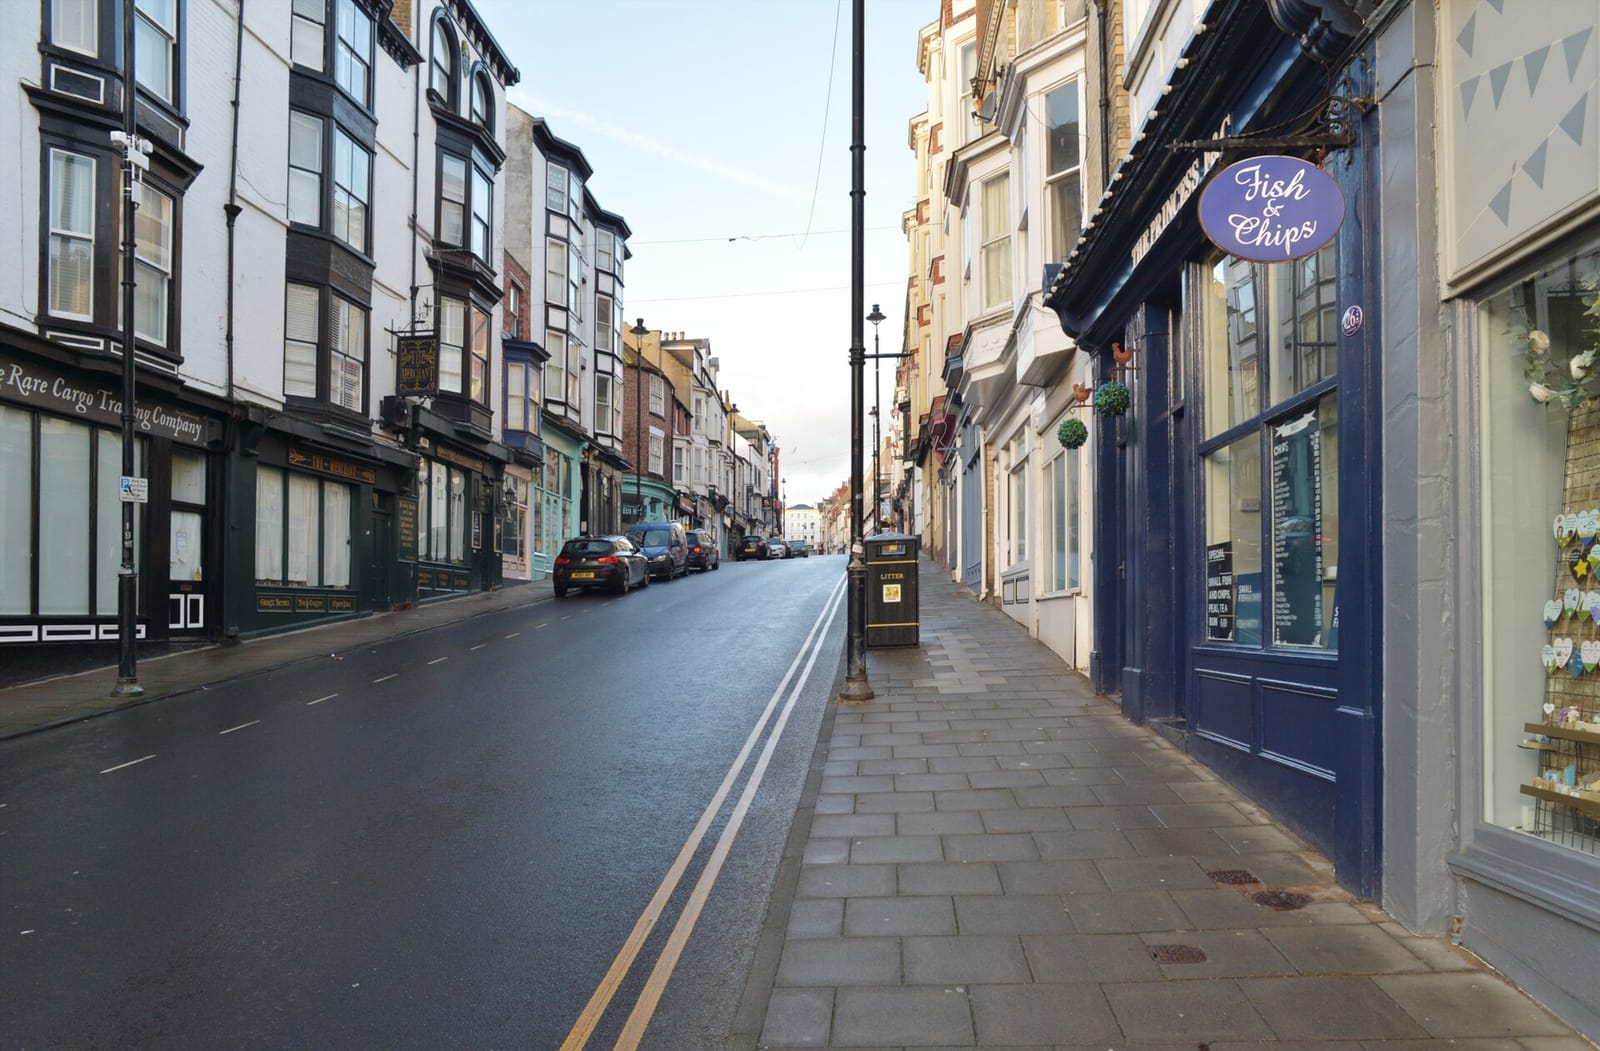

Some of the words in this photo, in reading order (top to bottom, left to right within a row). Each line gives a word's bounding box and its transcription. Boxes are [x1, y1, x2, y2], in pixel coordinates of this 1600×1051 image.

[1235, 164, 1312, 202] Fish
[1262, 198, 1285, 217] &
[1228, 214, 1318, 257] Chips
[6, 363, 48, 396] Rare
[52, 377, 94, 413] Cargo
[97, 388, 152, 430] Traing
[152, 405, 203, 441] Company
